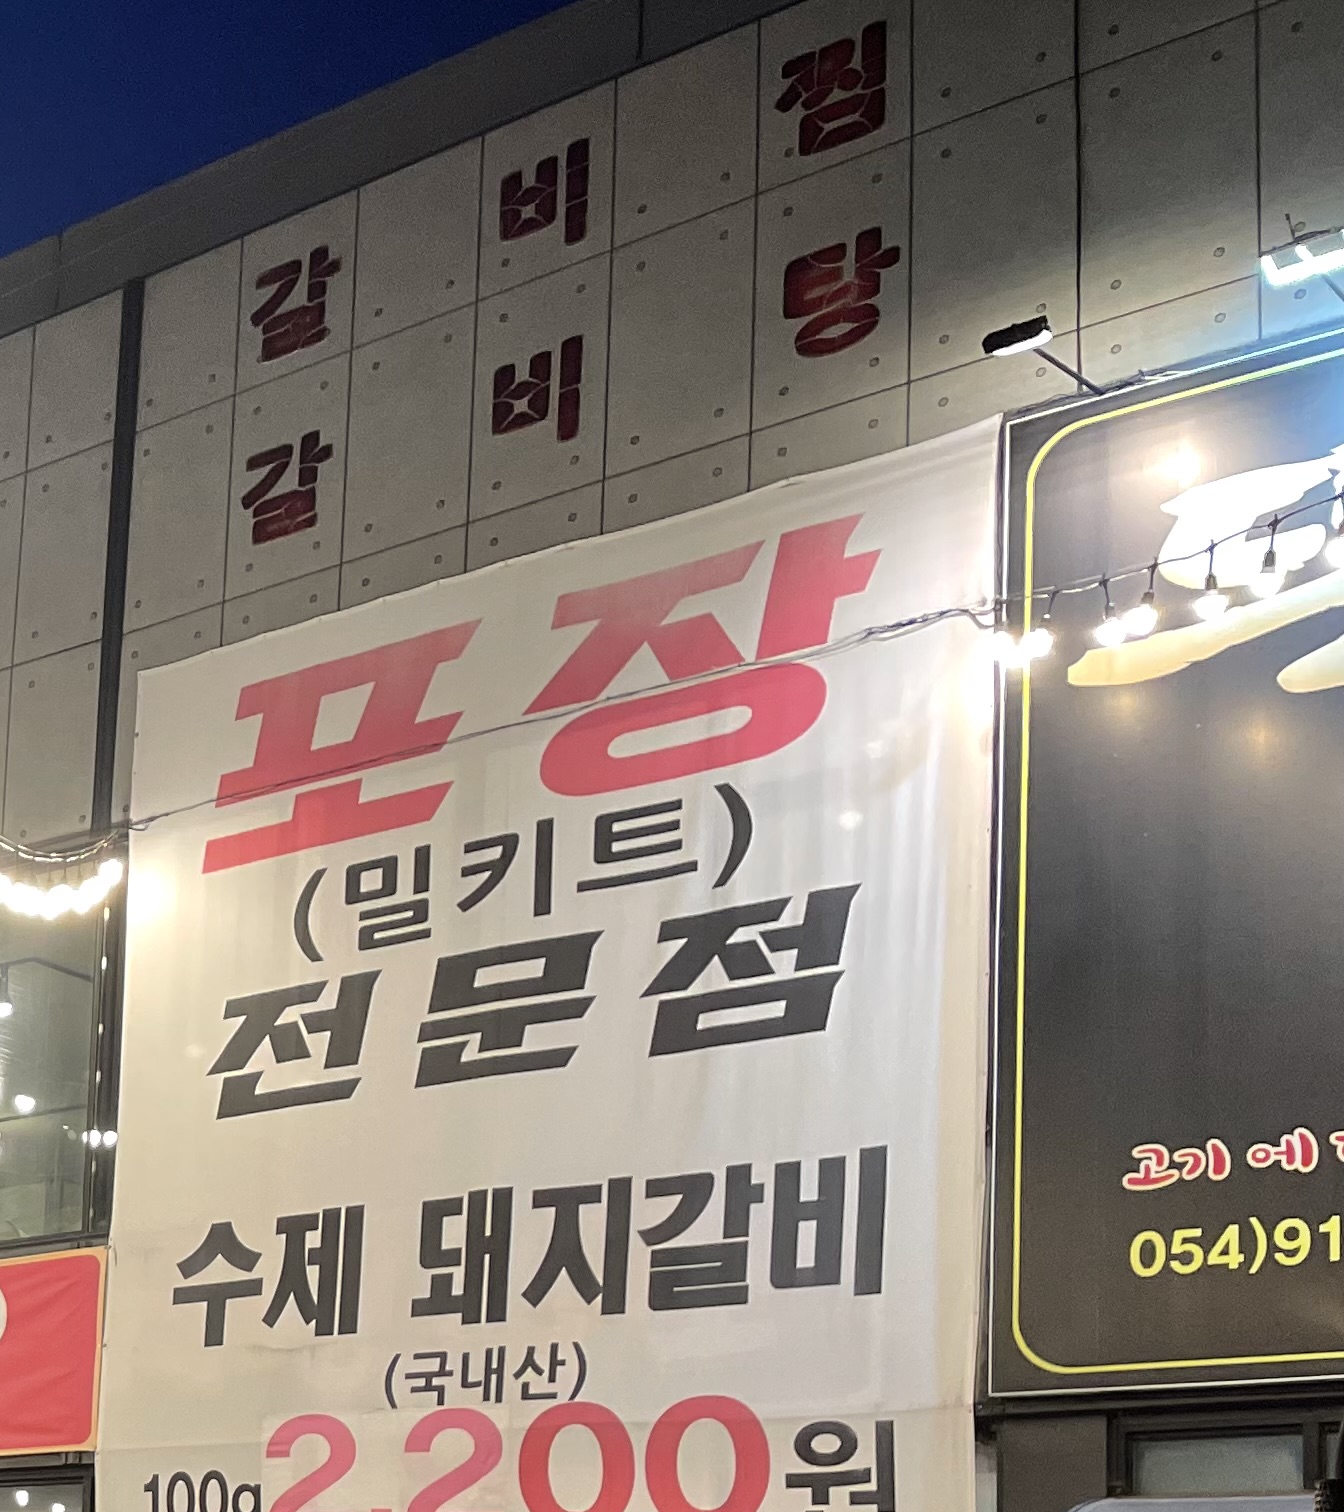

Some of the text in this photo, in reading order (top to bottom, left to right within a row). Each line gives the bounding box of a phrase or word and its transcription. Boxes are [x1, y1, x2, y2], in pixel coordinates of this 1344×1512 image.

[202, 513, 882, 874] 포장
[294, 784, 753, 962] (밀키트)
[207, 884, 862, 1121] 전문점
[172, 1145, 888, 1348] 수제 돼지갈비
[384, 1341, 589, 1409] (국내산)
